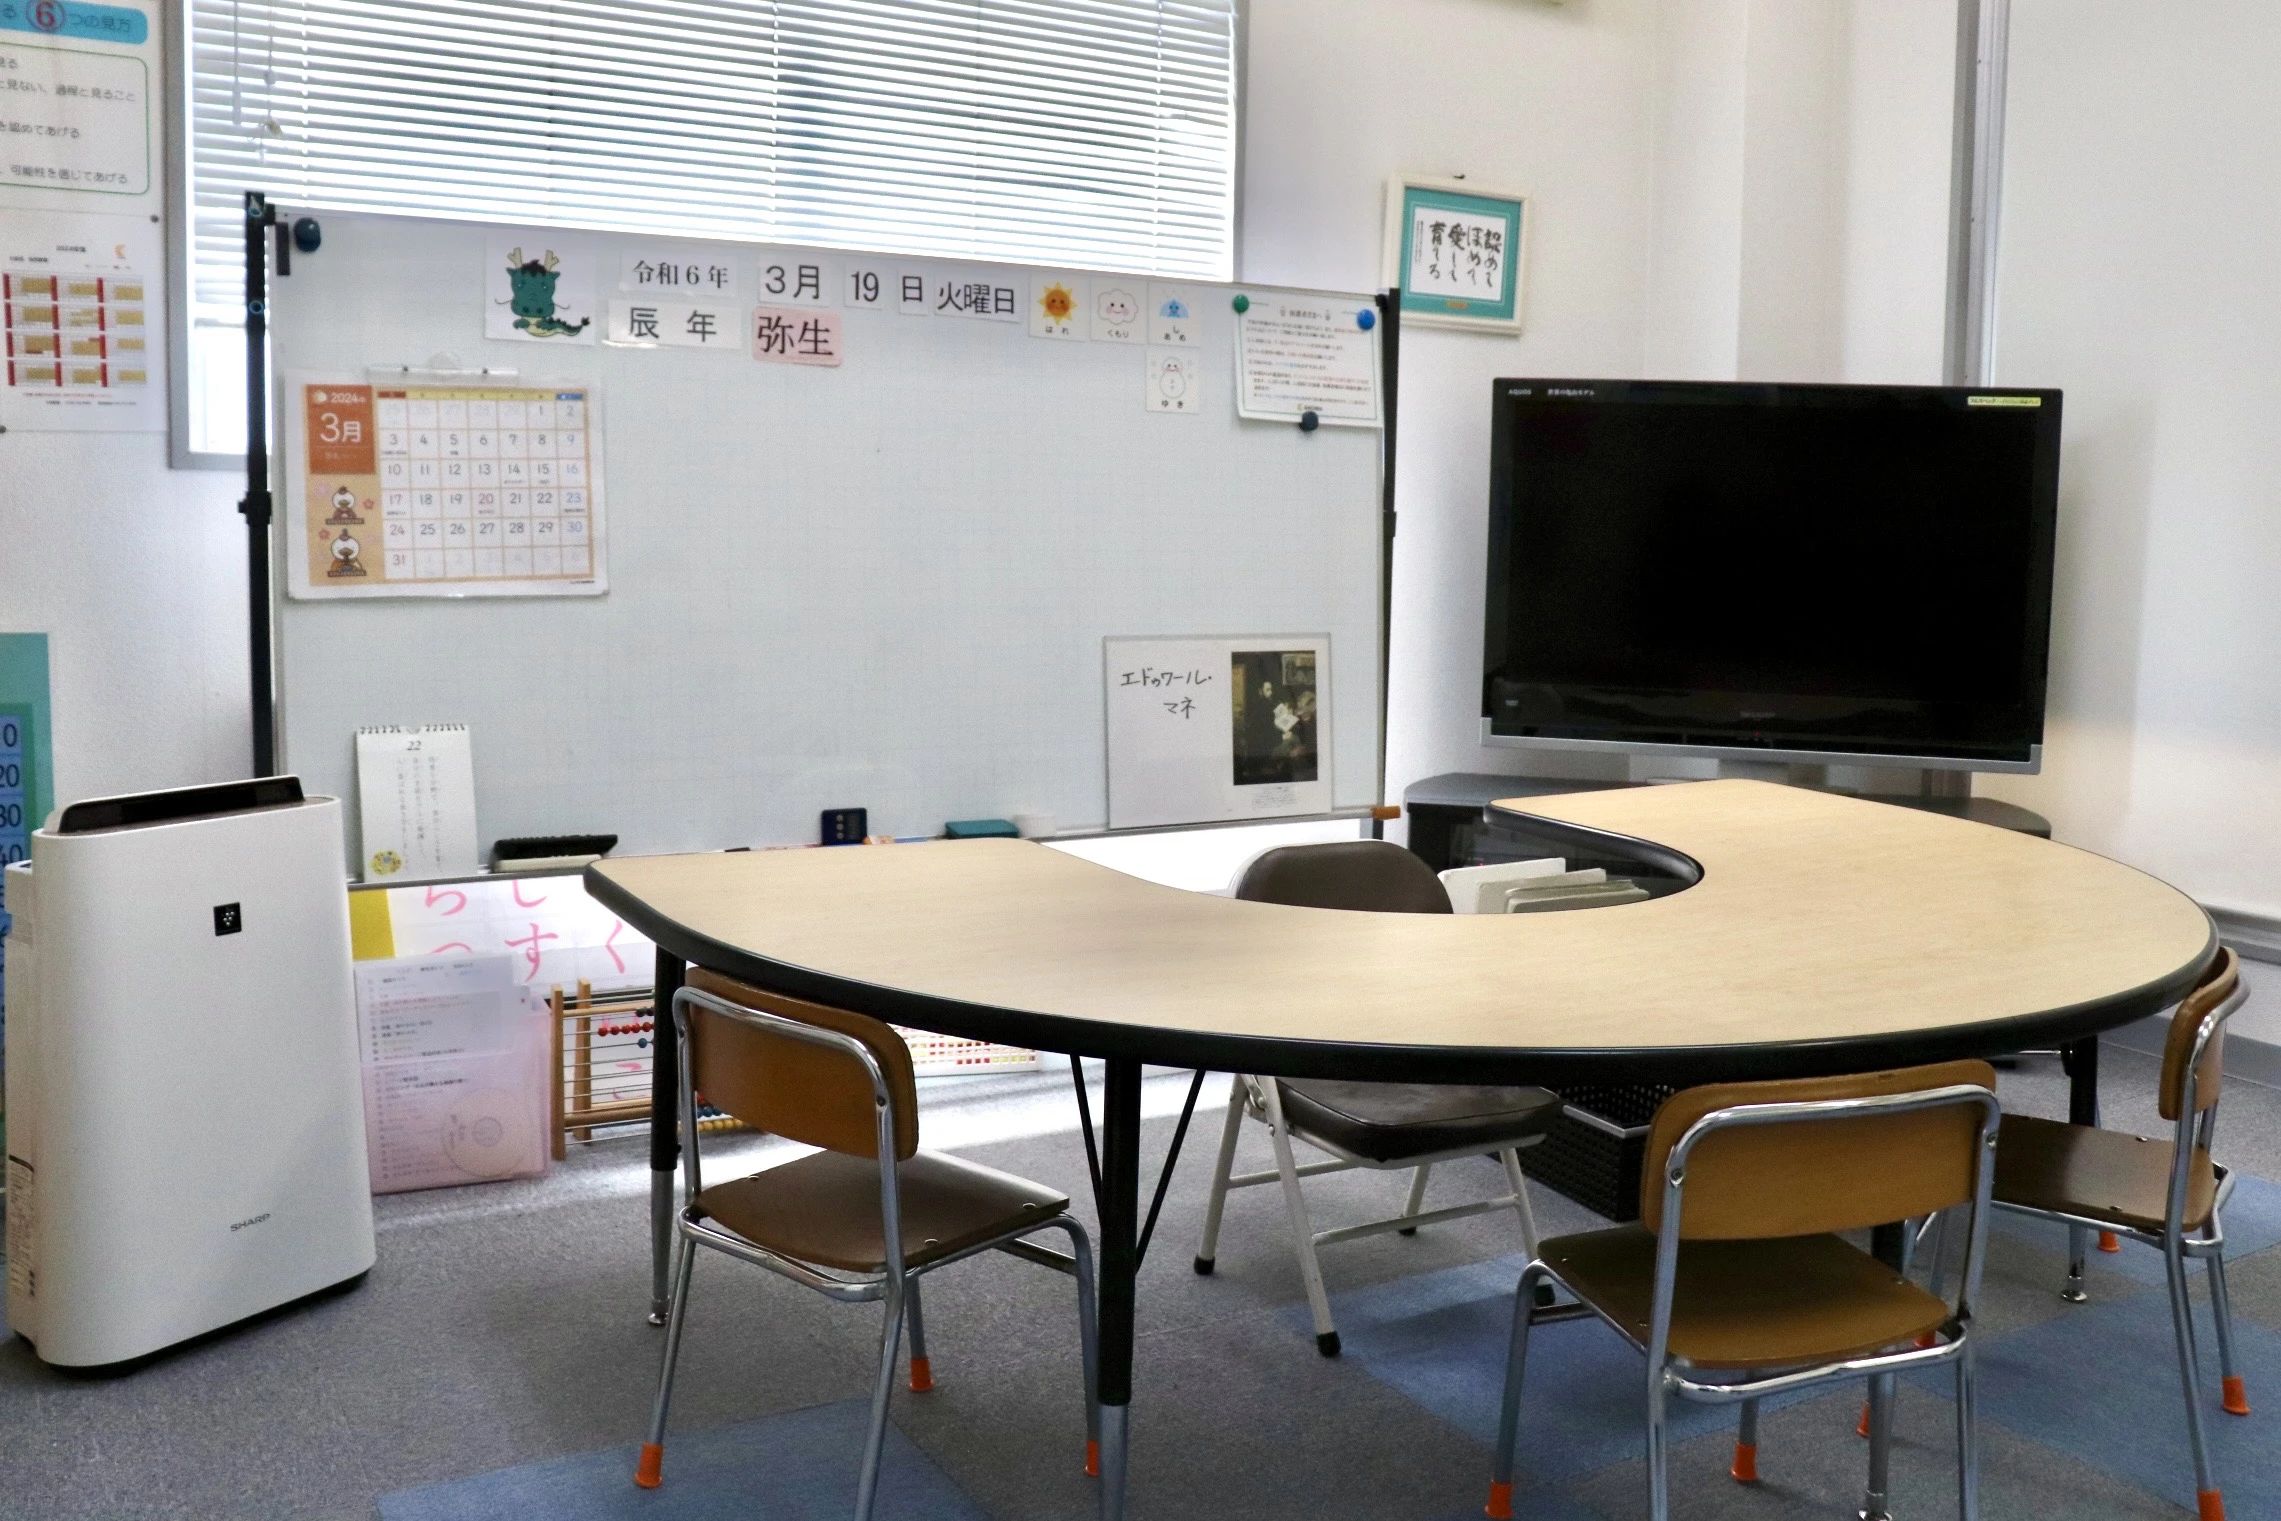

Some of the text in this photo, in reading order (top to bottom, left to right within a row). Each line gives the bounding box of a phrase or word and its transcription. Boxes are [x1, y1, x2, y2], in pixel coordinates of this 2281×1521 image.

[633, 260, 1015, 315] 令和6年 3月 19 日 火曜日
[628, 307, 834, 356] 辰年 弥生
[1045, 325, 1070, 336] はれ
[1107, 328, 1130, 339] くもり
[1161, 399, 1185, 410] ゆき
[320, 412, 362, 443] 3月
[390, 433, 575, 446] 3 4 5 6 7 8 9
[388, 463, 401, 475] 10
[420, 463, 430, 475] 11
[449, 463, 461, 475] 12
[479, 463, 491, 475] 13
[508, 463, 520, 475] 14
[538, 463, 549, 475] 15
[389, 491, 582, 505] 17 18 19 20 21 22 23
[389, 523, 405, 535] 24
[420, 523, 436, 535] 25
[450, 523, 466, 535] 26
[479, 522, 495, 534] 27
[509, 522, 524, 534] 28
[538, 521, 553, 533] 29
[393, 554, 405, 566] 31
[1163, 696, 1196, 719] マネ
[505, 919, 626, 982] す く
[230, 1213, 271, 1231] SHARP
